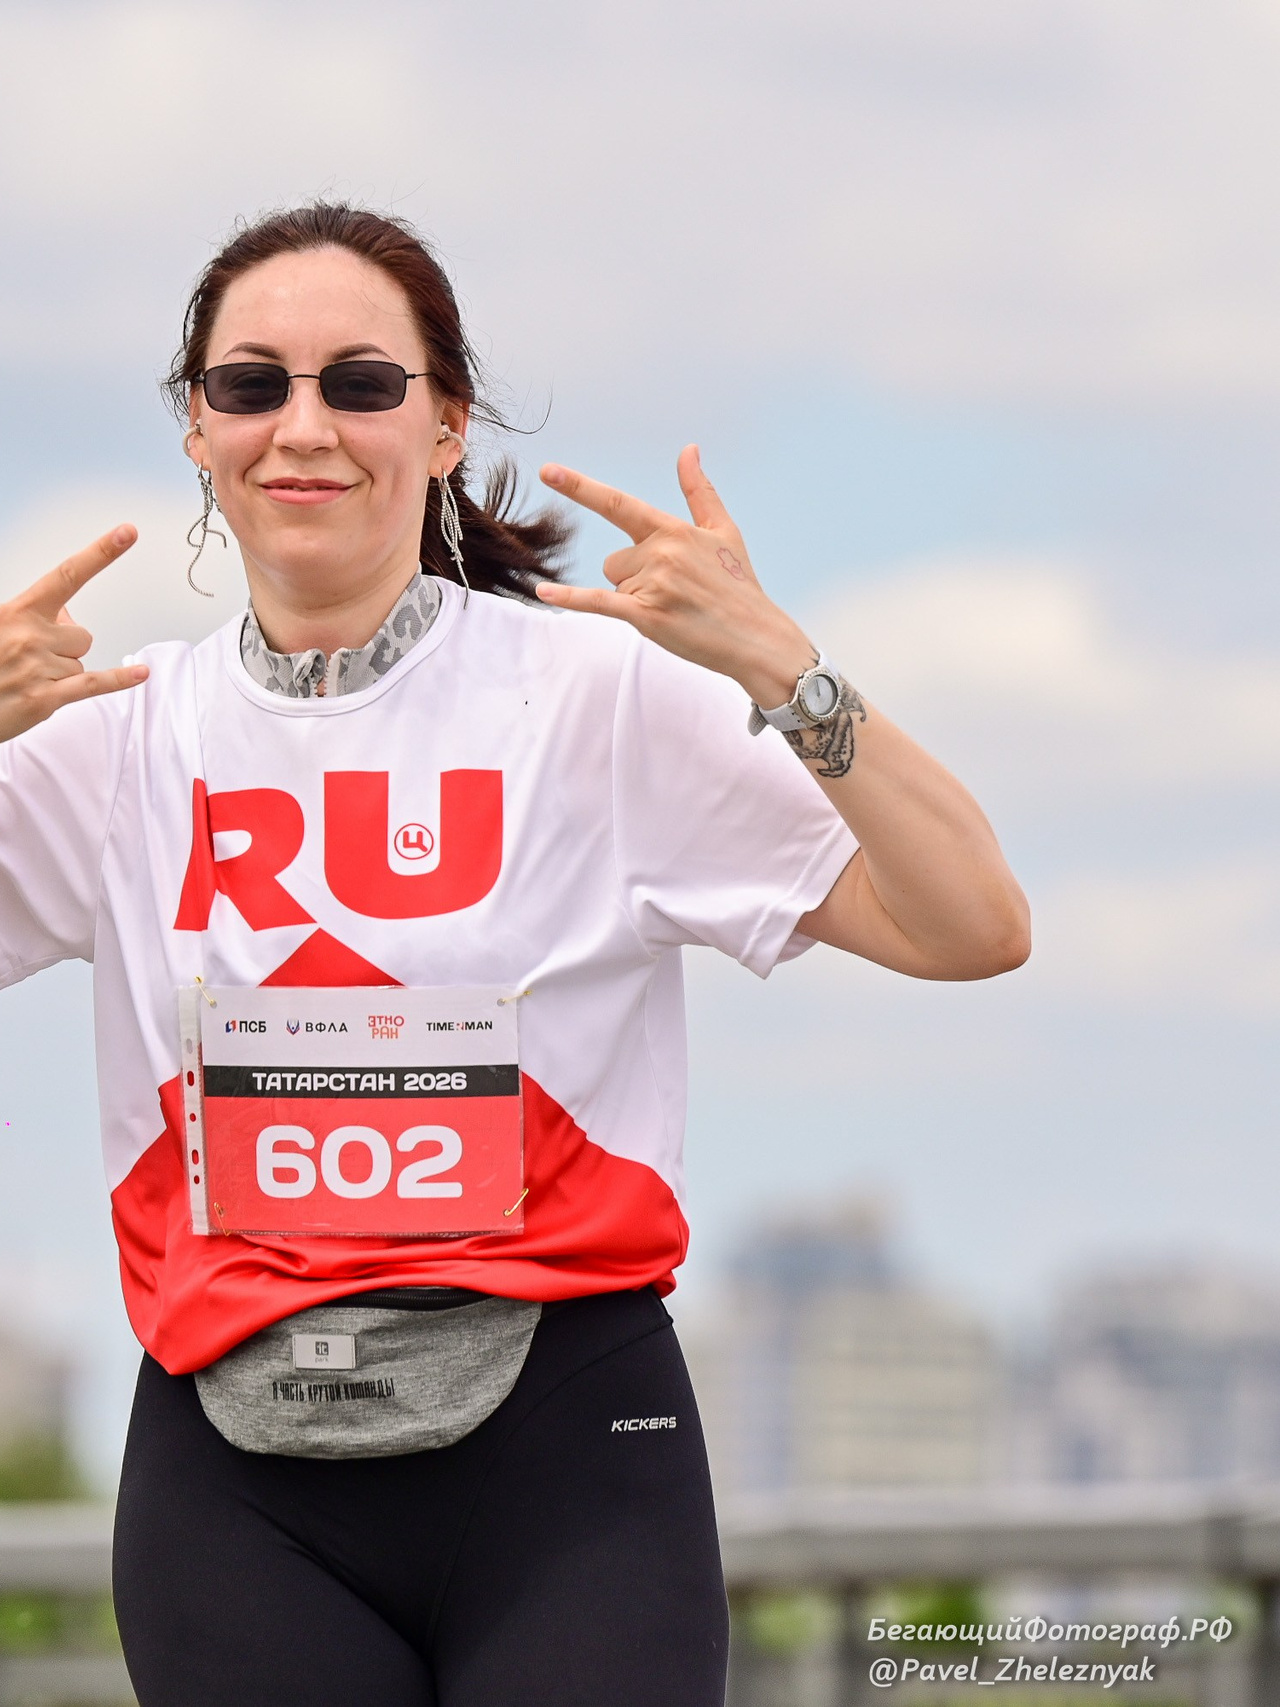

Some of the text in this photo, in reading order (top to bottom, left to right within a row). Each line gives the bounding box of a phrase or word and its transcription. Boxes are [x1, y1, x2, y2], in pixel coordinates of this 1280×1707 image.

[240, 1020, 267, 1033] ПСБ
[305, 1021, 348, 1033] ВФЛА
[368, 1015, 405, 1028] ЭТНО
[252, 1072, 468, 1093] ТАТАРСТАН 2026
[256, 1125, 464, 1200] 602
[611, 1416, 677, 1432] KICKERS
